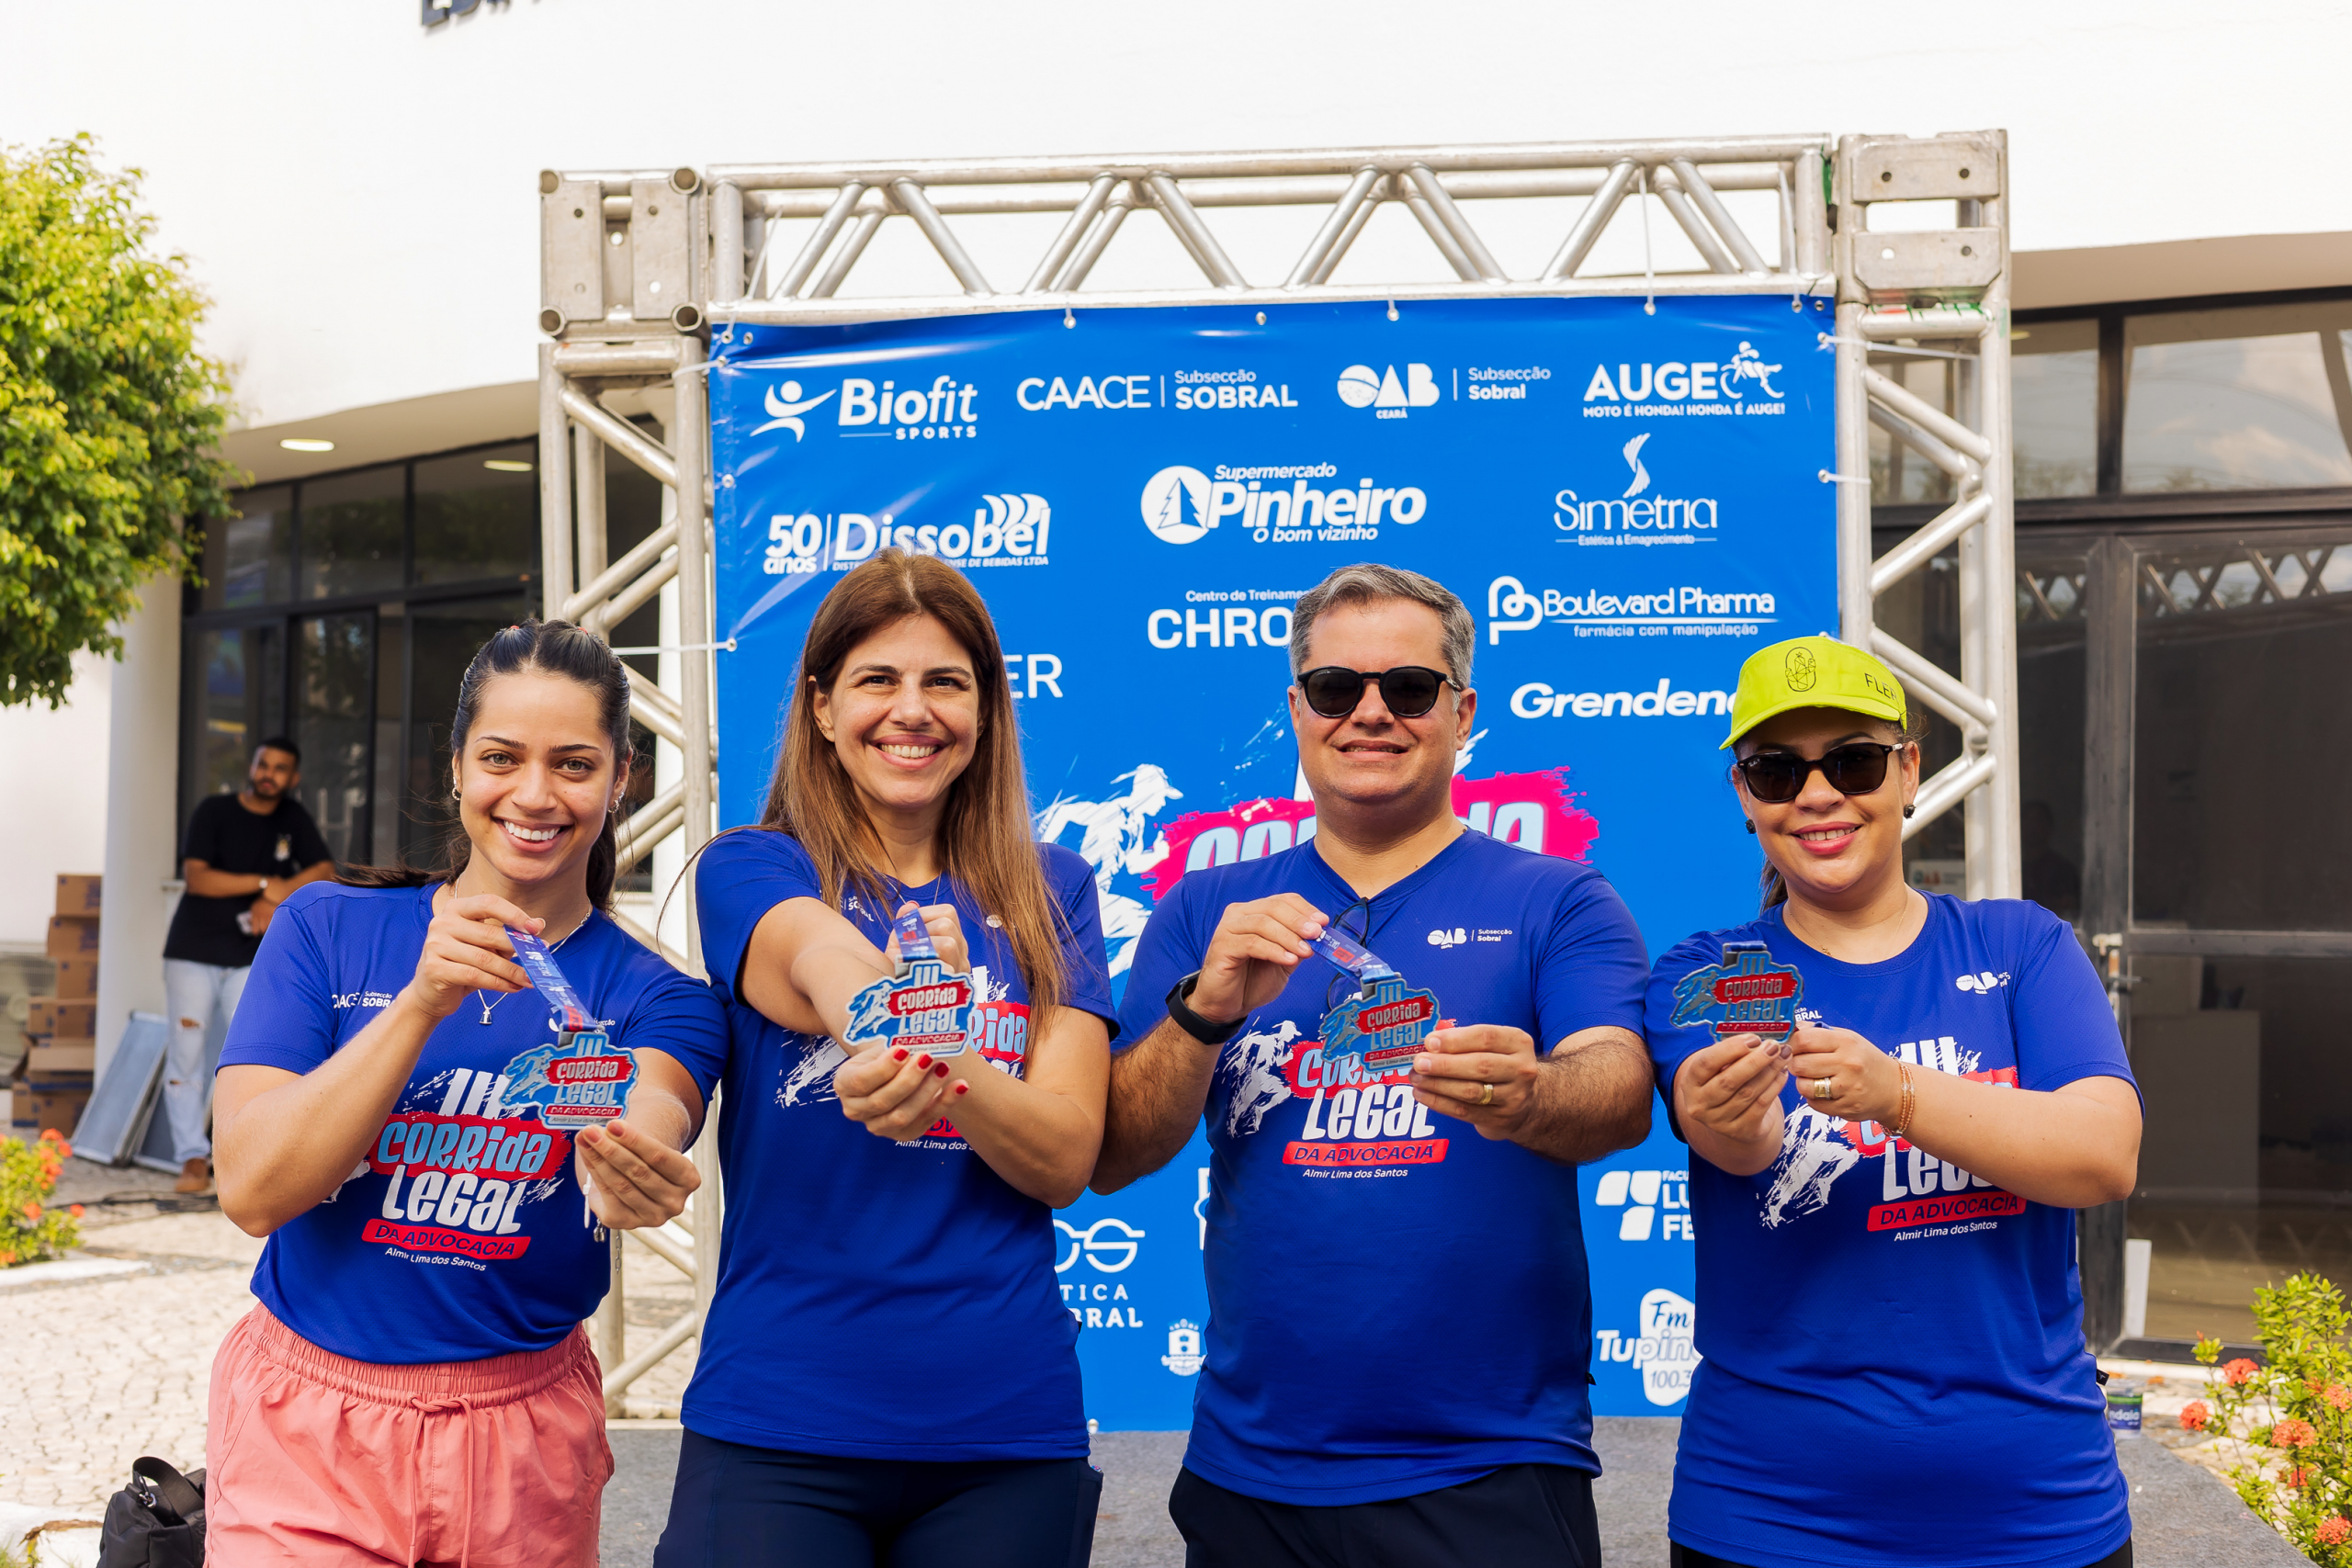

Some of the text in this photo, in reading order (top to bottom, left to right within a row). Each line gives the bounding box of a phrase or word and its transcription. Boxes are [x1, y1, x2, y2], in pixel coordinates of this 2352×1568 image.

[1174, 368, 1257, 386] Subsecção
[1468, 366, 1552, 383] Subsecção
[1583, 361, 1719, 401] AUGE
[1016, 376, 1151, 412] CAACE
[1337, 363, 1440, 408] OAB
[1468, 383, 1527, 400] Sobral
[838, 375, 978, 426] Biofit
[1174, 384, 1299, 410] SOBRAL
[1375, 407, 1408, 419] CEARÁ
[1583, 401, 1786, 418] MOTO É HONDA! HONDA É AUGE!
[895, 425, 978, 441] SPORTS
[1214, 461, 1337, 482] Supermercado
[1205, 477, 1427, 529] Pinheiro
[764, 513, 824, 558] 50
[834, 507, 1052, 558] Dissobel
[1252, 525, 1378, 544] O bom vizinho
[1577, 533, 1696, 547] Estética & Emagrecimento
[763, 557, 818, 575] anos
[982, 557, 1023, 567] BEBIDAS
[1023, 556, 1049, 566] LTDA
[1185, 588, 1308, 603] Centro de Treiname
[1543, 586, 1775, 616] Boulevard Pharma
[1574, 623, 1758, 638] farmácia com manipulação
[1427, 927, 1467, 946] OAB
[362, 997, 396, 1009] SOBR
[1795, 1010, 1823, 1022] BRAL
[564, 1107, 616, 1115] ADVOCACIA
[923, 1139, 947, 1150] Lima
[948, 1141, 967, 1150] dos
[1294, 1144, 1433, 1162] DA ADVOCACIA
[1303, 1168, 1408, 1179] Almir Lima dos Santos
[1880, 1196, 2018, 1225] DA ADVOCACIA
[374, 1224, 515, 1256] DA ADVOCACIA
[1894, 1221, 1997, 1242] Almir Lima dos Santos
[385, 1247, 487, 1271] Almir Lima dos Santos
[1058, 1283, 1129, 1301] TICA
[1649, 1301, 1690, 1328] Fm
